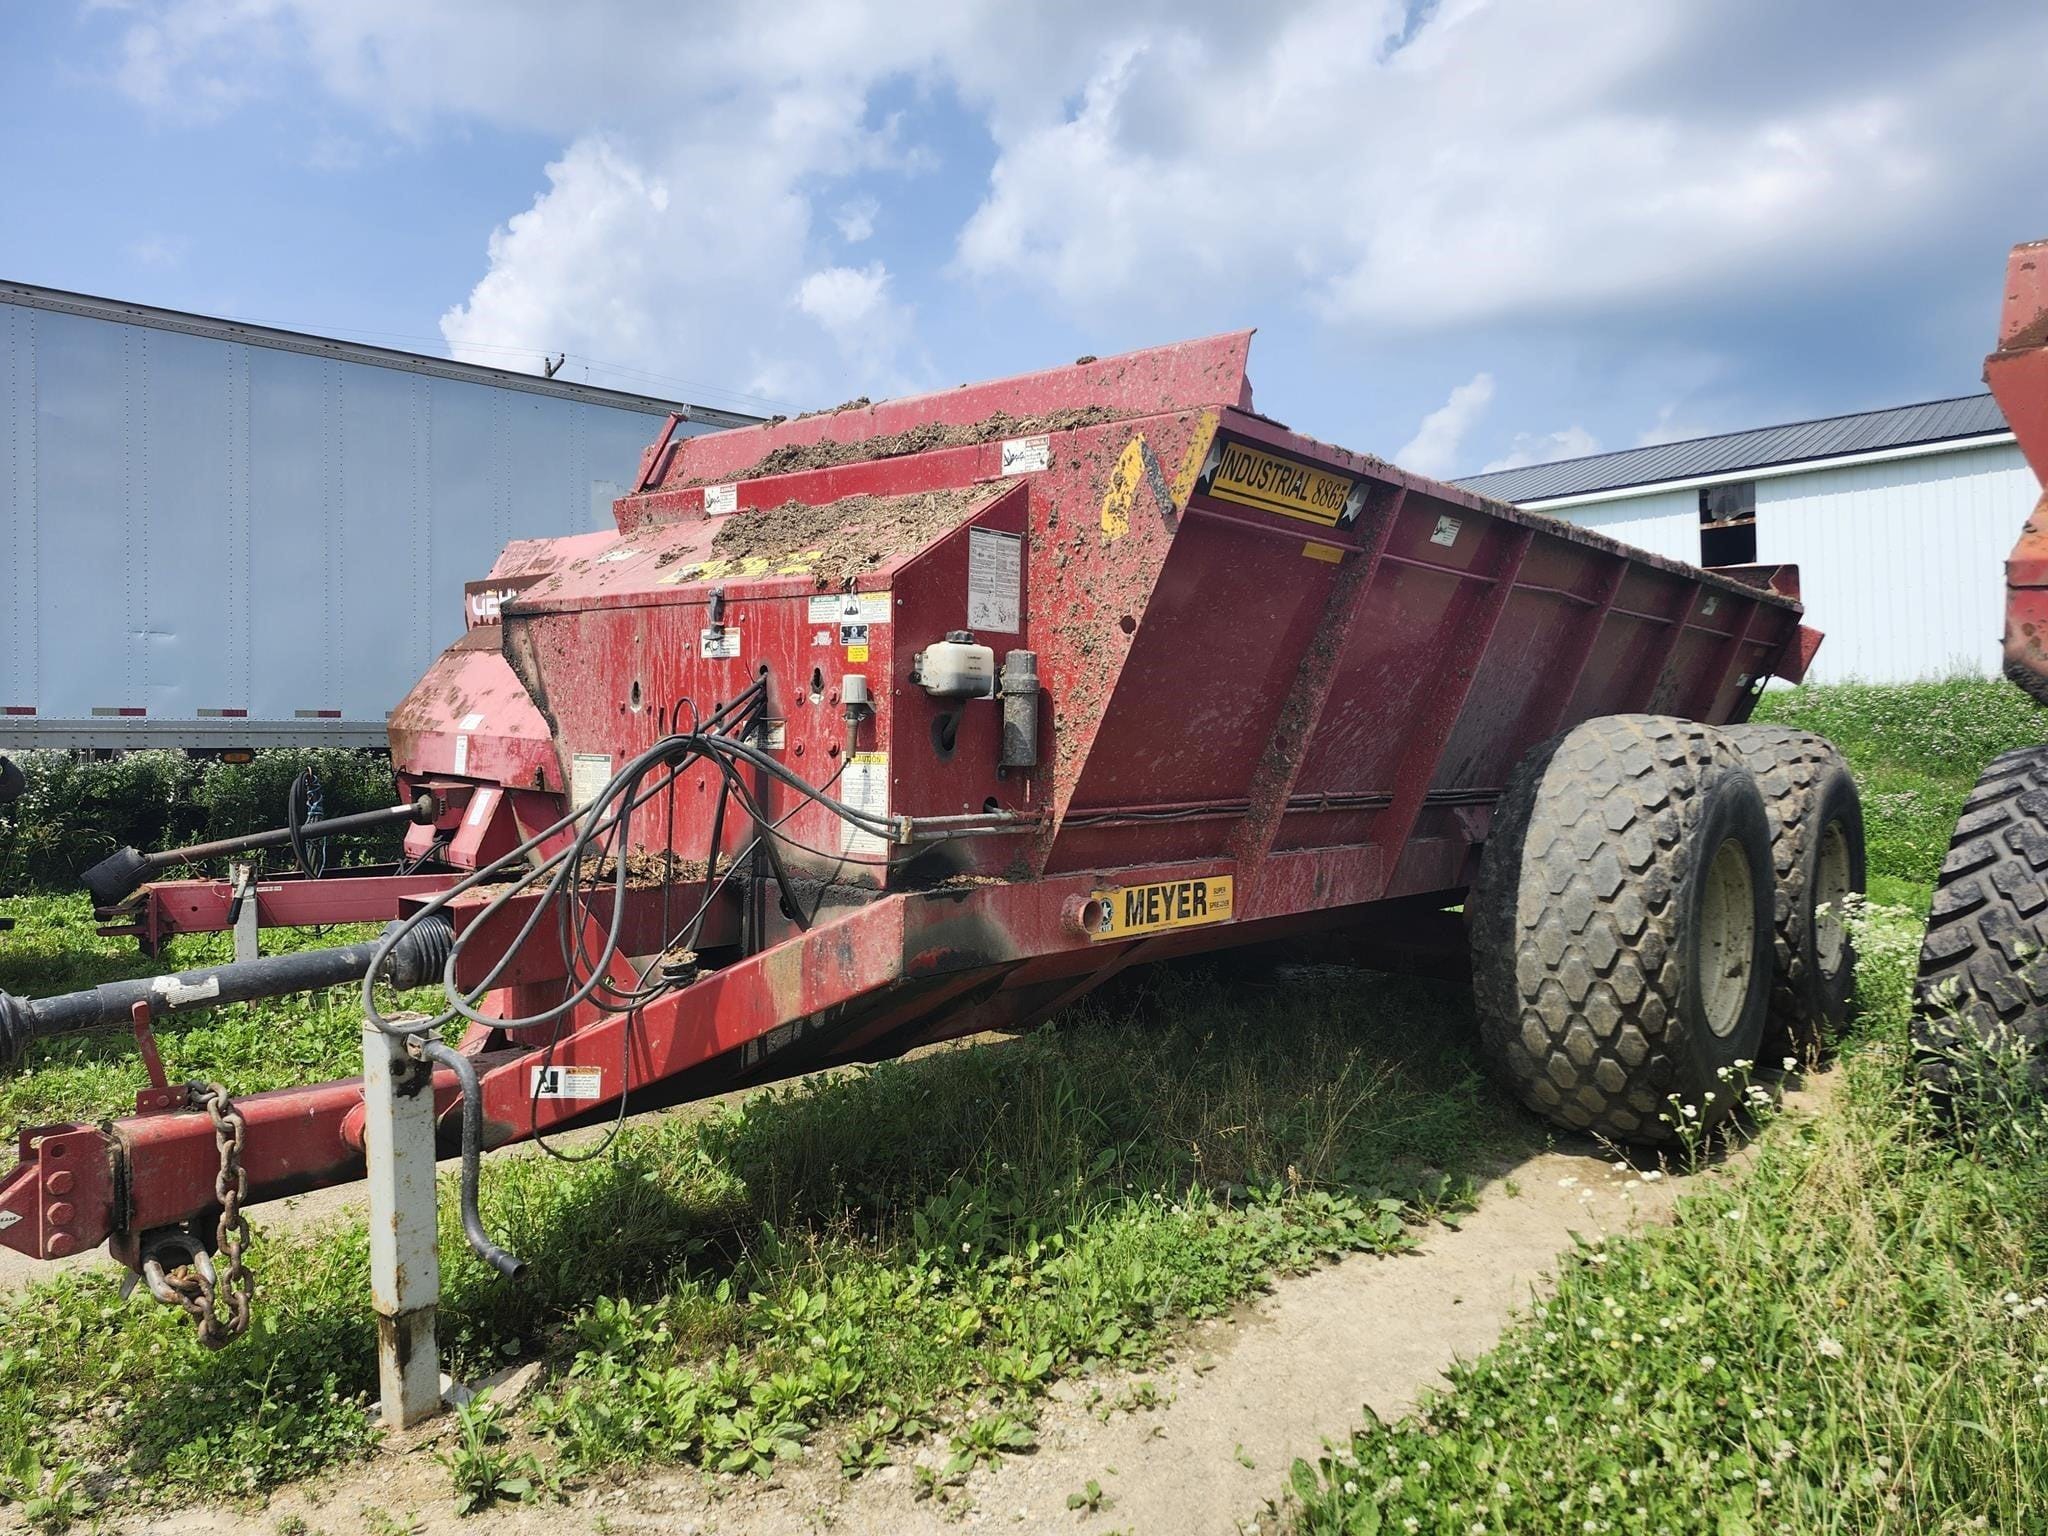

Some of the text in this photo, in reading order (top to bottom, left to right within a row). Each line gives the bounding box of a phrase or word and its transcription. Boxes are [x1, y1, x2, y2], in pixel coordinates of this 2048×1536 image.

[1218, 449, 1348, 511] INDUSTRIAL 8865
[1125, 882, 1207, 927] MEYER
